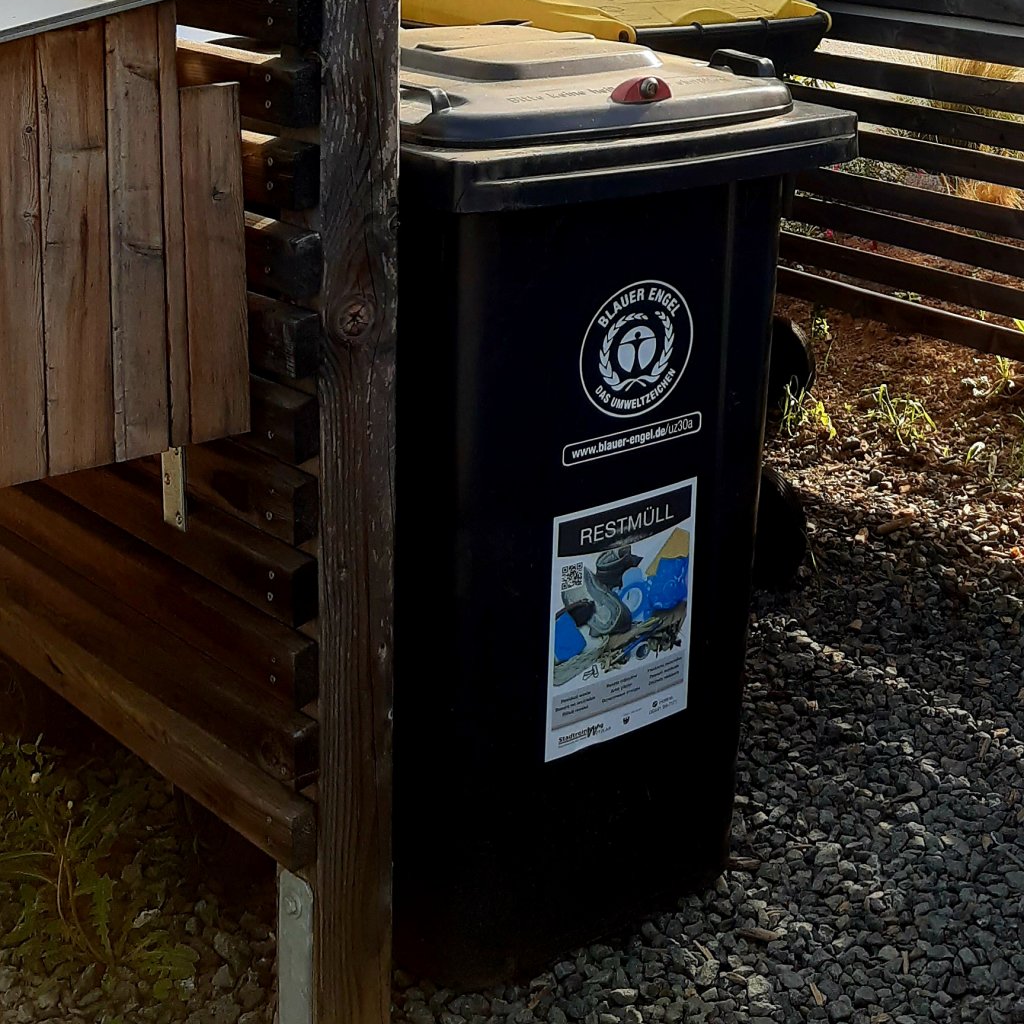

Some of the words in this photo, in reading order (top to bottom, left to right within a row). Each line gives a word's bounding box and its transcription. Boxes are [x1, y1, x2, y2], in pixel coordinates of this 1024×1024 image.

[597, 287, 646, 329] BLAUER
[648, 287, 681, 318] ENGEL
[595, 384, 611, 404] DAS
[610, 367, 677, 410] UMWELTZEICHEN
[571, 417, 694, 460] www.blauer-engel.de/uz30a
[579, 503, 675, 546] RESTMÜLL
